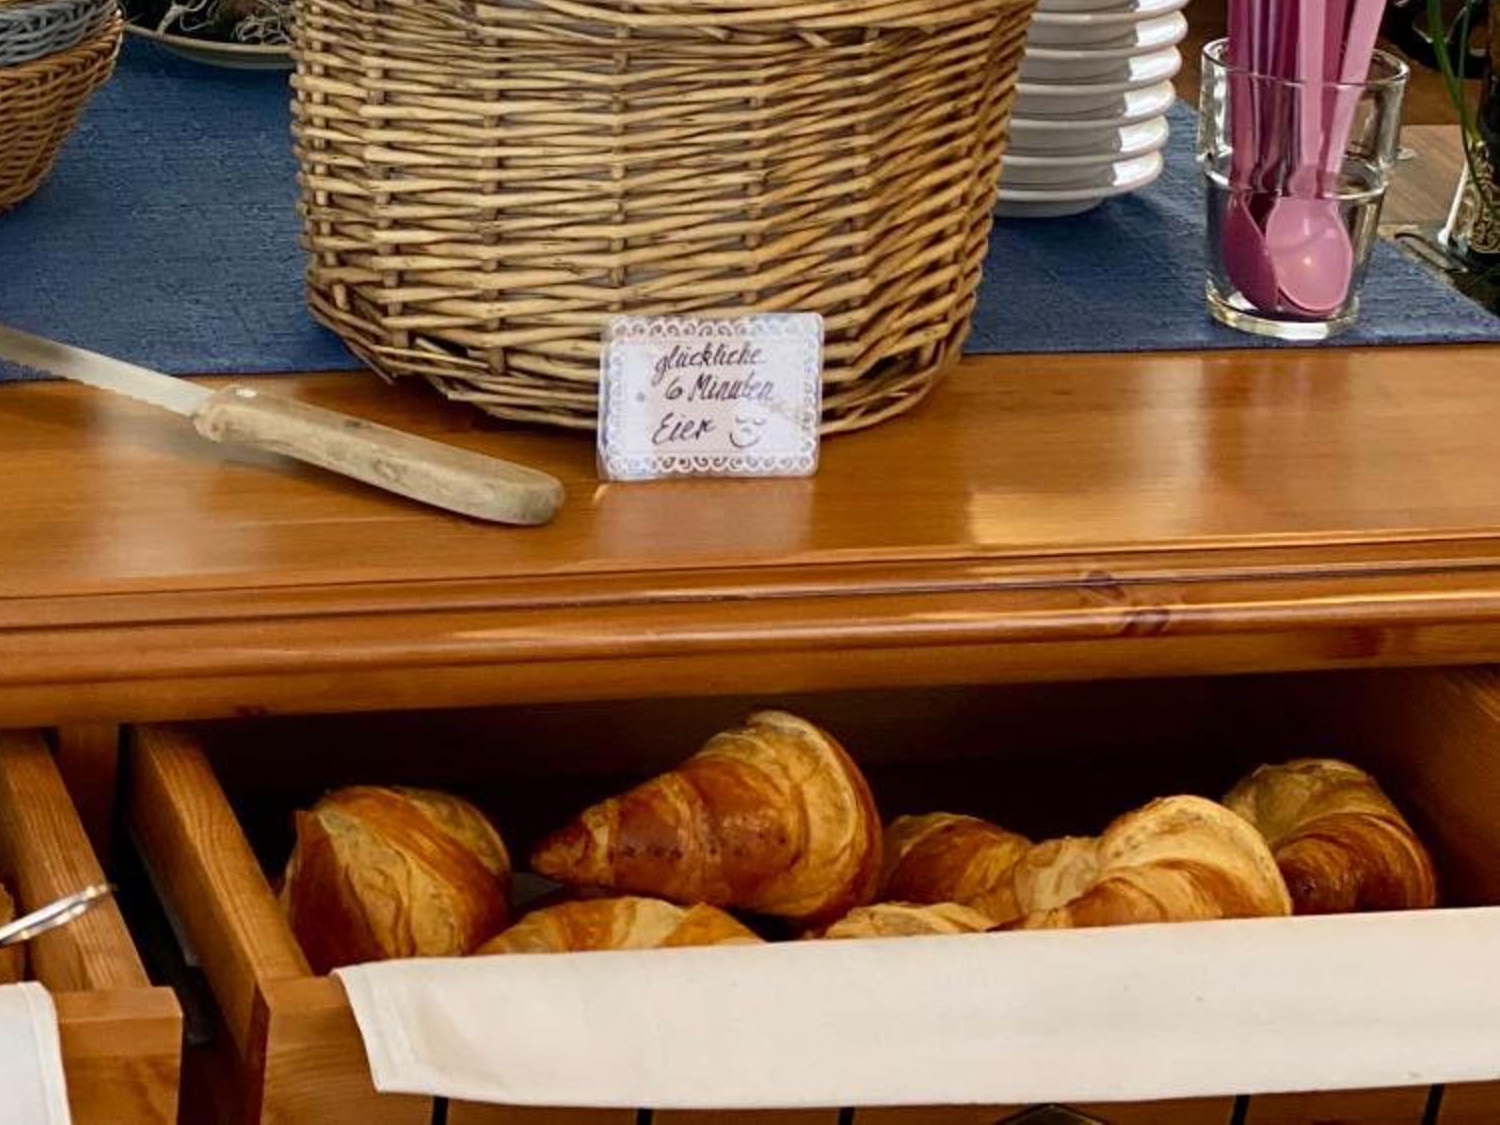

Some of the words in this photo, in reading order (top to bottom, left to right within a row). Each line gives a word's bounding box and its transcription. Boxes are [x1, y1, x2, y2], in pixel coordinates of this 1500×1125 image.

[665, 375, 684, 400] 6
[687, 370, 774, 402] Minuten
[651, 411, 716, 445] Eier
